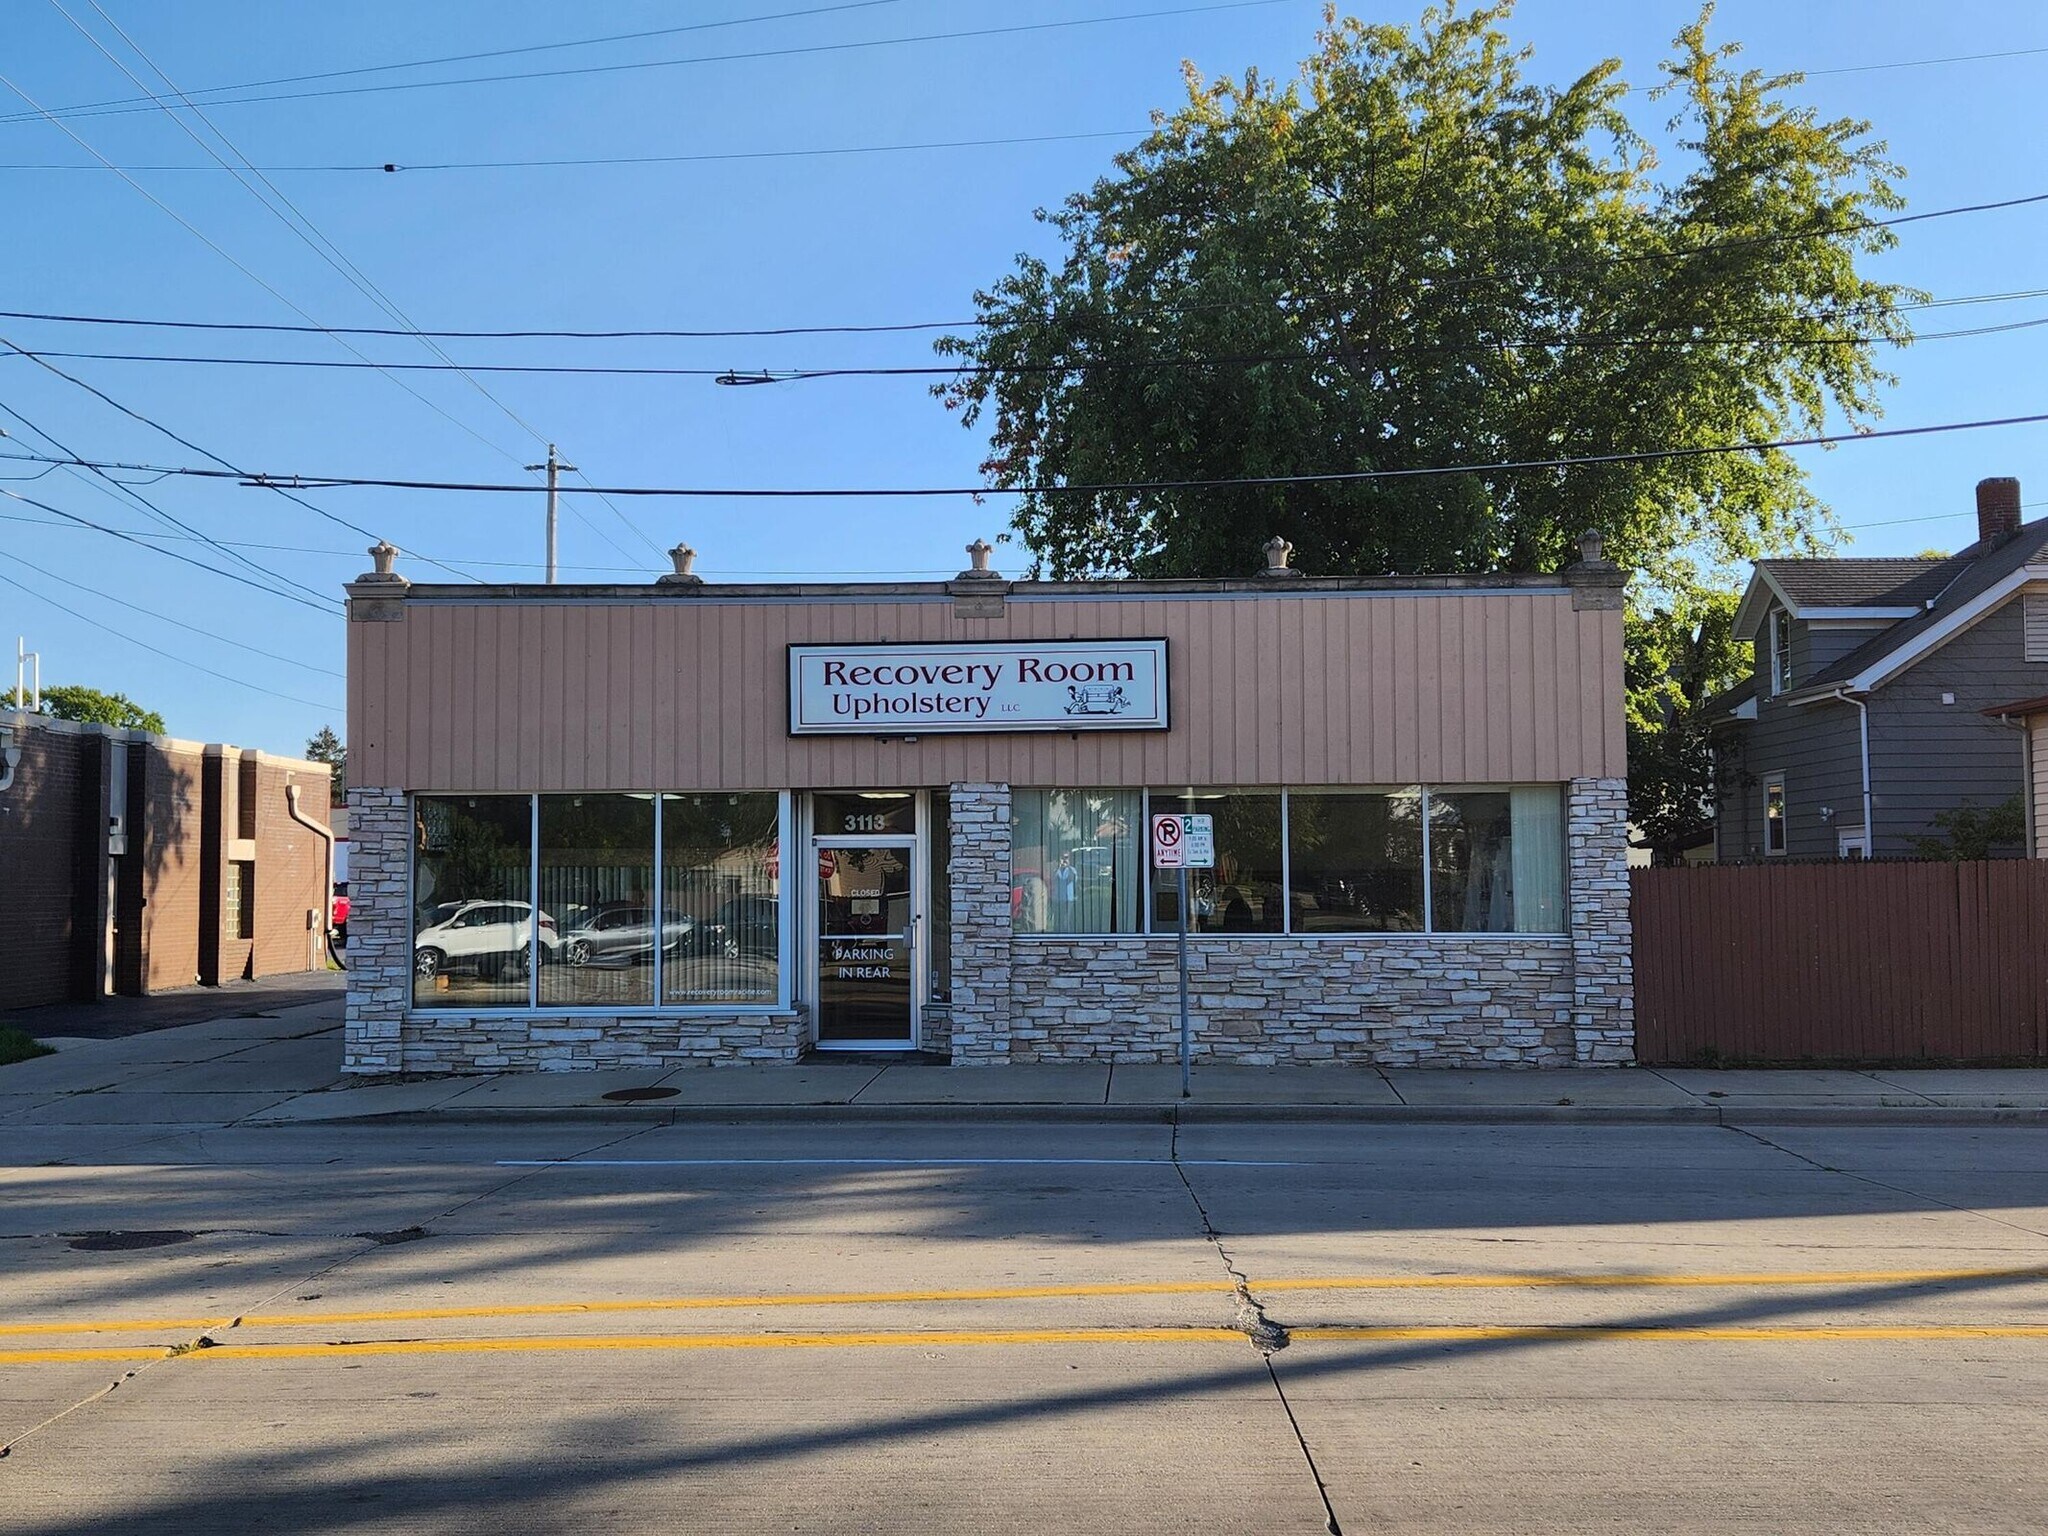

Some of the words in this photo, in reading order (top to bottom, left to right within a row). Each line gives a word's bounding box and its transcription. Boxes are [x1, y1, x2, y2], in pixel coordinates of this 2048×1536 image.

[822, 660, 1003, 690] Recovery
[1017, 658, 1135, 683] Room
[832, 692, 992, 719] Upholstery
[1001, 704, 1021, 712] LLC
[1184, 818, 1192, 832] 2
[1157, 848, 1181, 857] ANYTIME
[851, 889, 880, 897] CLOSED
[835, 948, 894, 960] PARKING
[839, 967, 853, 978] IN
[856, 967, 891, 978] REAR
